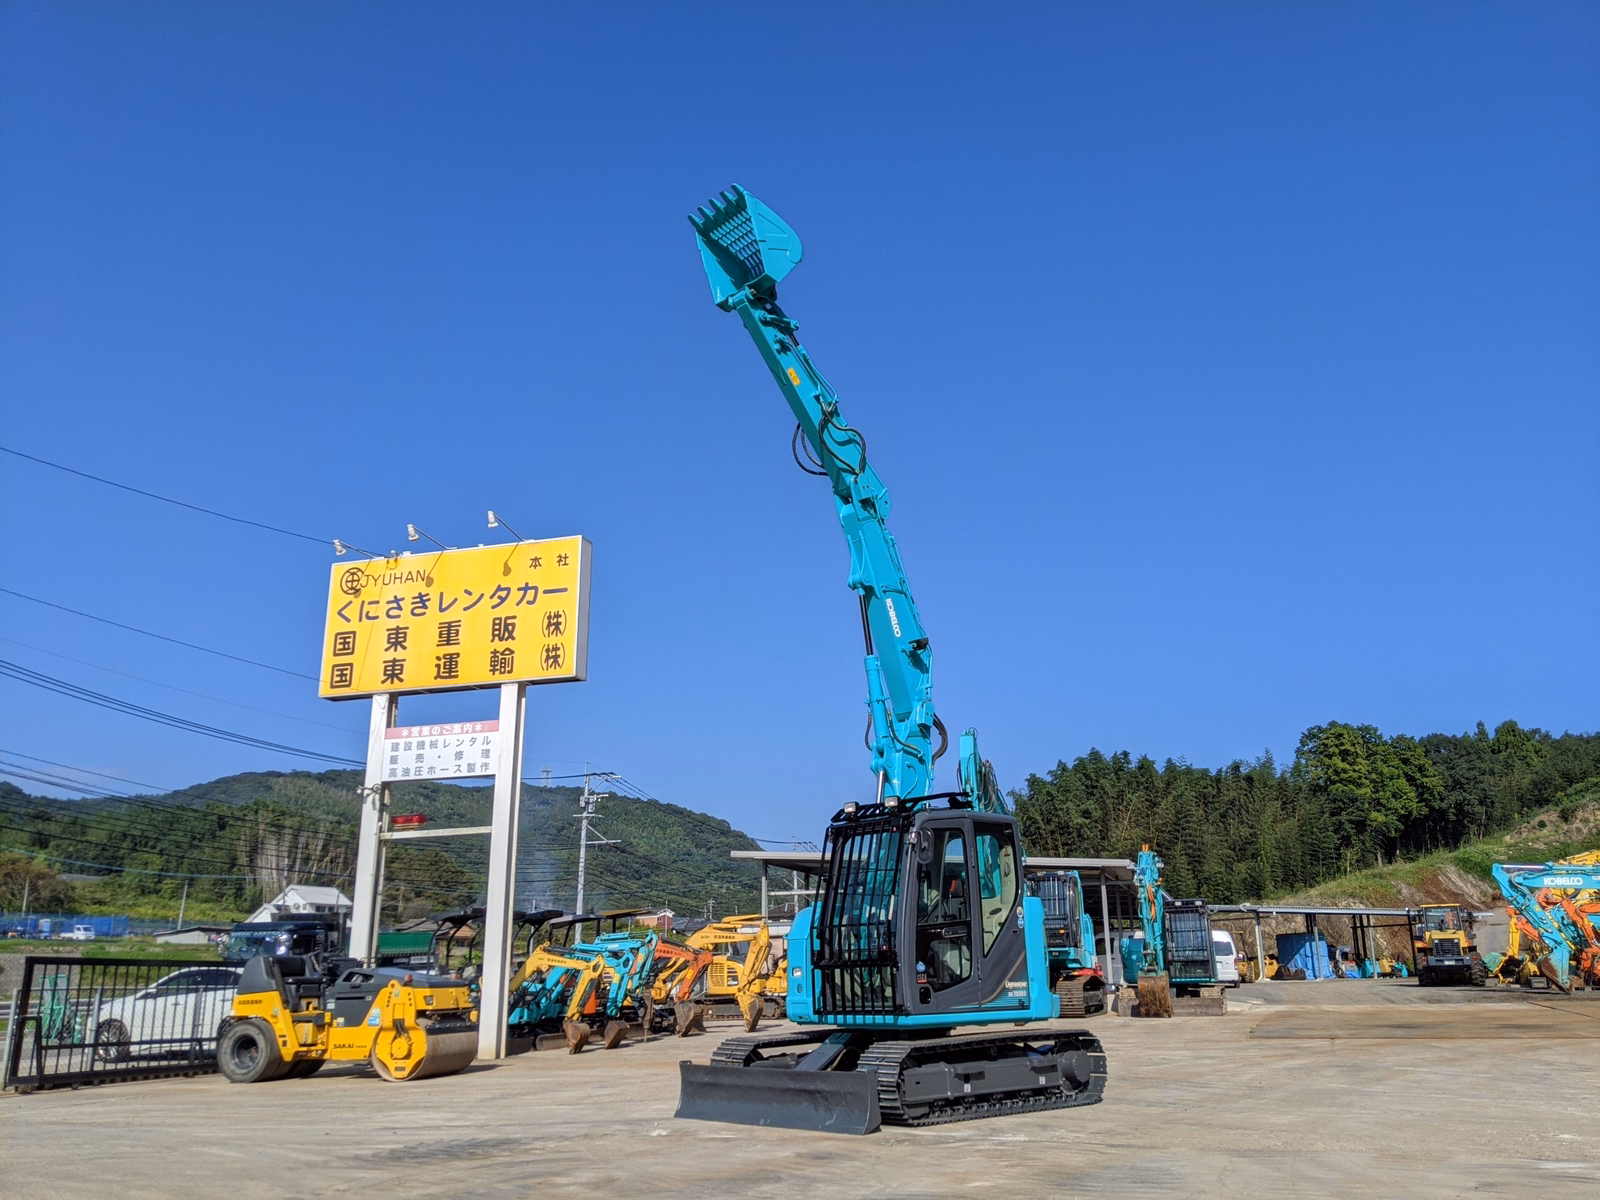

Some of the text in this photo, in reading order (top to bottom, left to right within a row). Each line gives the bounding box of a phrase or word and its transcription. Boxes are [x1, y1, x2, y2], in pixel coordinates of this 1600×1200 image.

[528, 553, 570, 570] 本社
[360, 569, 426, 588] JYUHAN
[336, 581, 568, 623] くにさきレンタカー
[885, 598, 902, 637] KOBELCO
[390, 735, 492, 752] 建設機械レンタル
[388, 762, 490, 778] 高油圧ホース製作
[1543, 877, 1583, 885] KOBELCO
